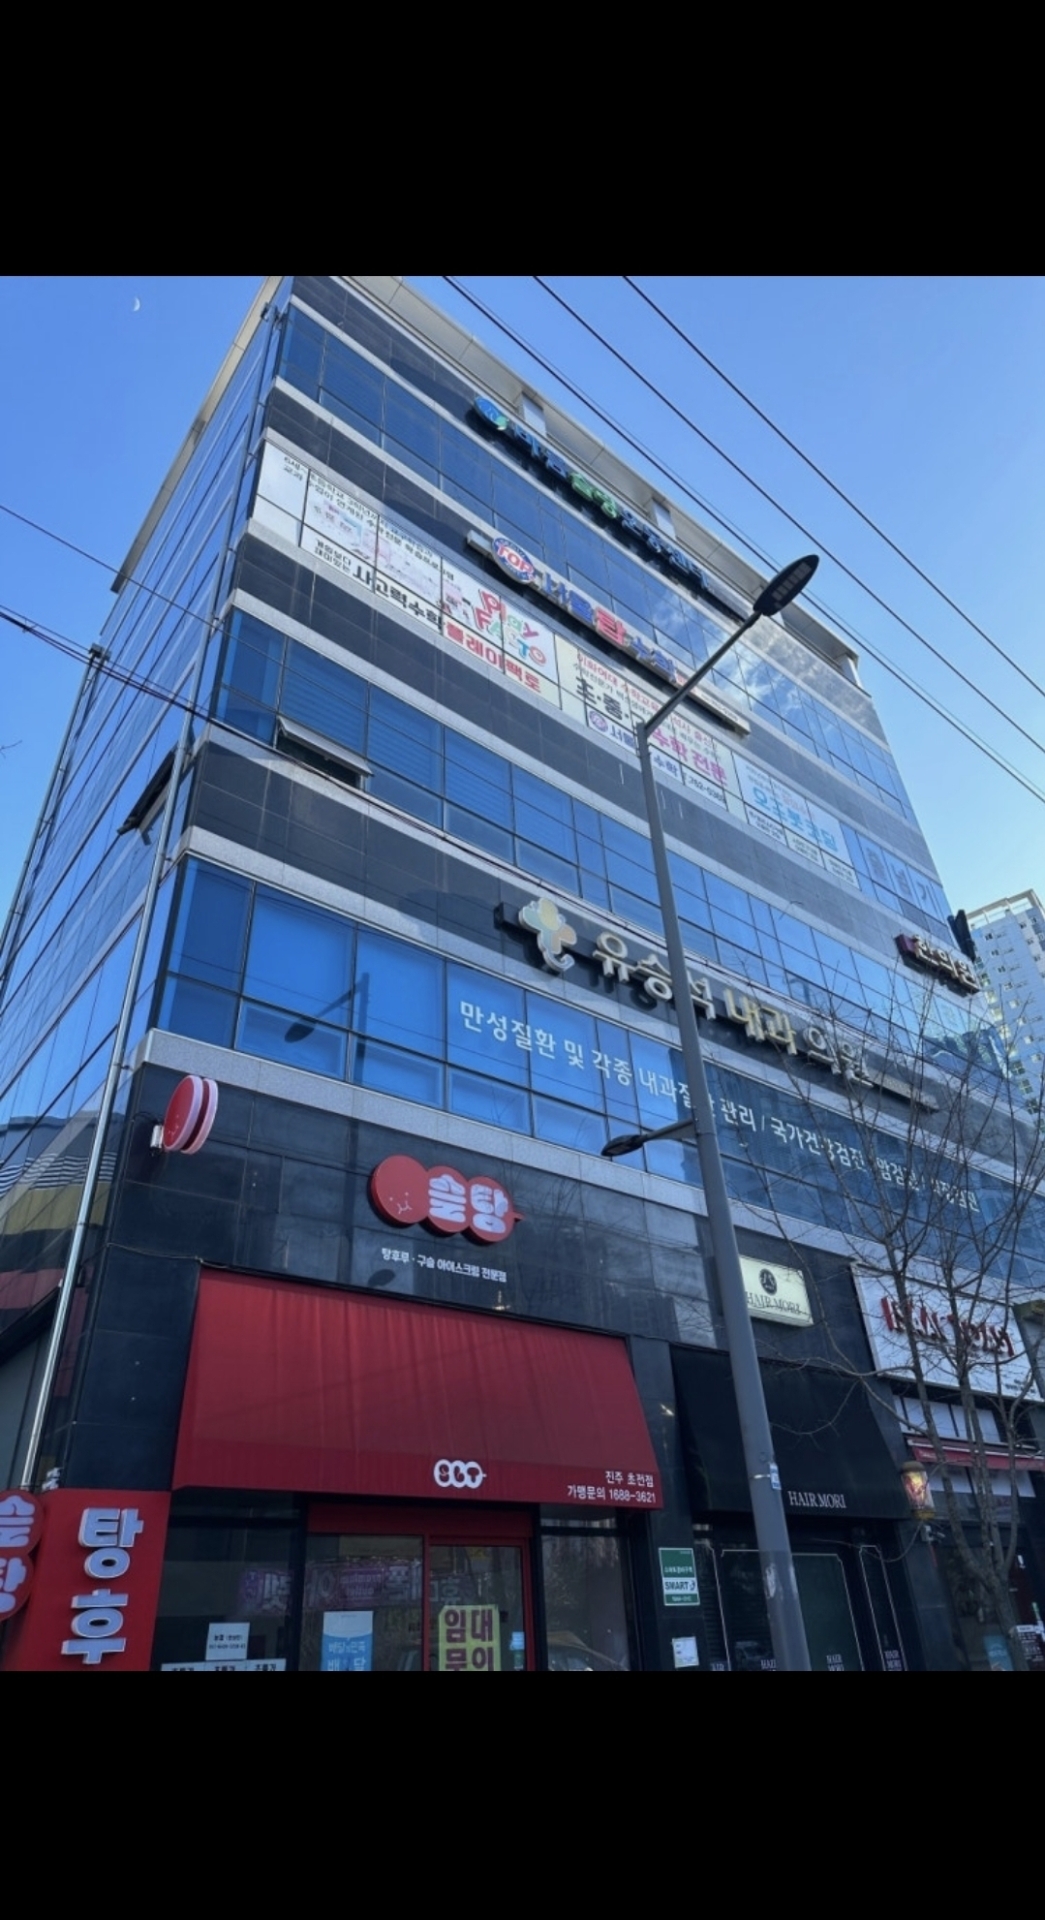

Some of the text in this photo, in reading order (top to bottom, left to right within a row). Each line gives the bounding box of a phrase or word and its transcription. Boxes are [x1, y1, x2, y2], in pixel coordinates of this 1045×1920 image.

[497, 544, 534, 579] TOP
[353, 565, 541, 694] 사고력수학 플레이팩토
[652, 727, 688, 763] 수학
[691, 747, 728, 787] 전문
[723, 987, 798, 1057] 내과
[803, 1026, 874, 1089] 의원
[460, 1000, 557, 1060] 만성질환
[563, 1039, 585, 1071] 및
[591, 1049, 634, 1087] 각종
[720, 1097, 757, 1132] 관리
[381, 1247, 410, 1264] 탕후루
[417, 1254, 436, 1270] 구슬
[437, 1258, 481, 1279] 아이스크림
[481, 1266, 508, 1284] 전문점
[567, 1484, 657, 1504] 가맹문의 1688-3621
[605, 1470, 625, 1485] 진주
[788, 1490, 847, 1509] HAIR MORI
[664, 1581, 690, 1591] SMART
[444, 1608, 494, 1644] 임대
